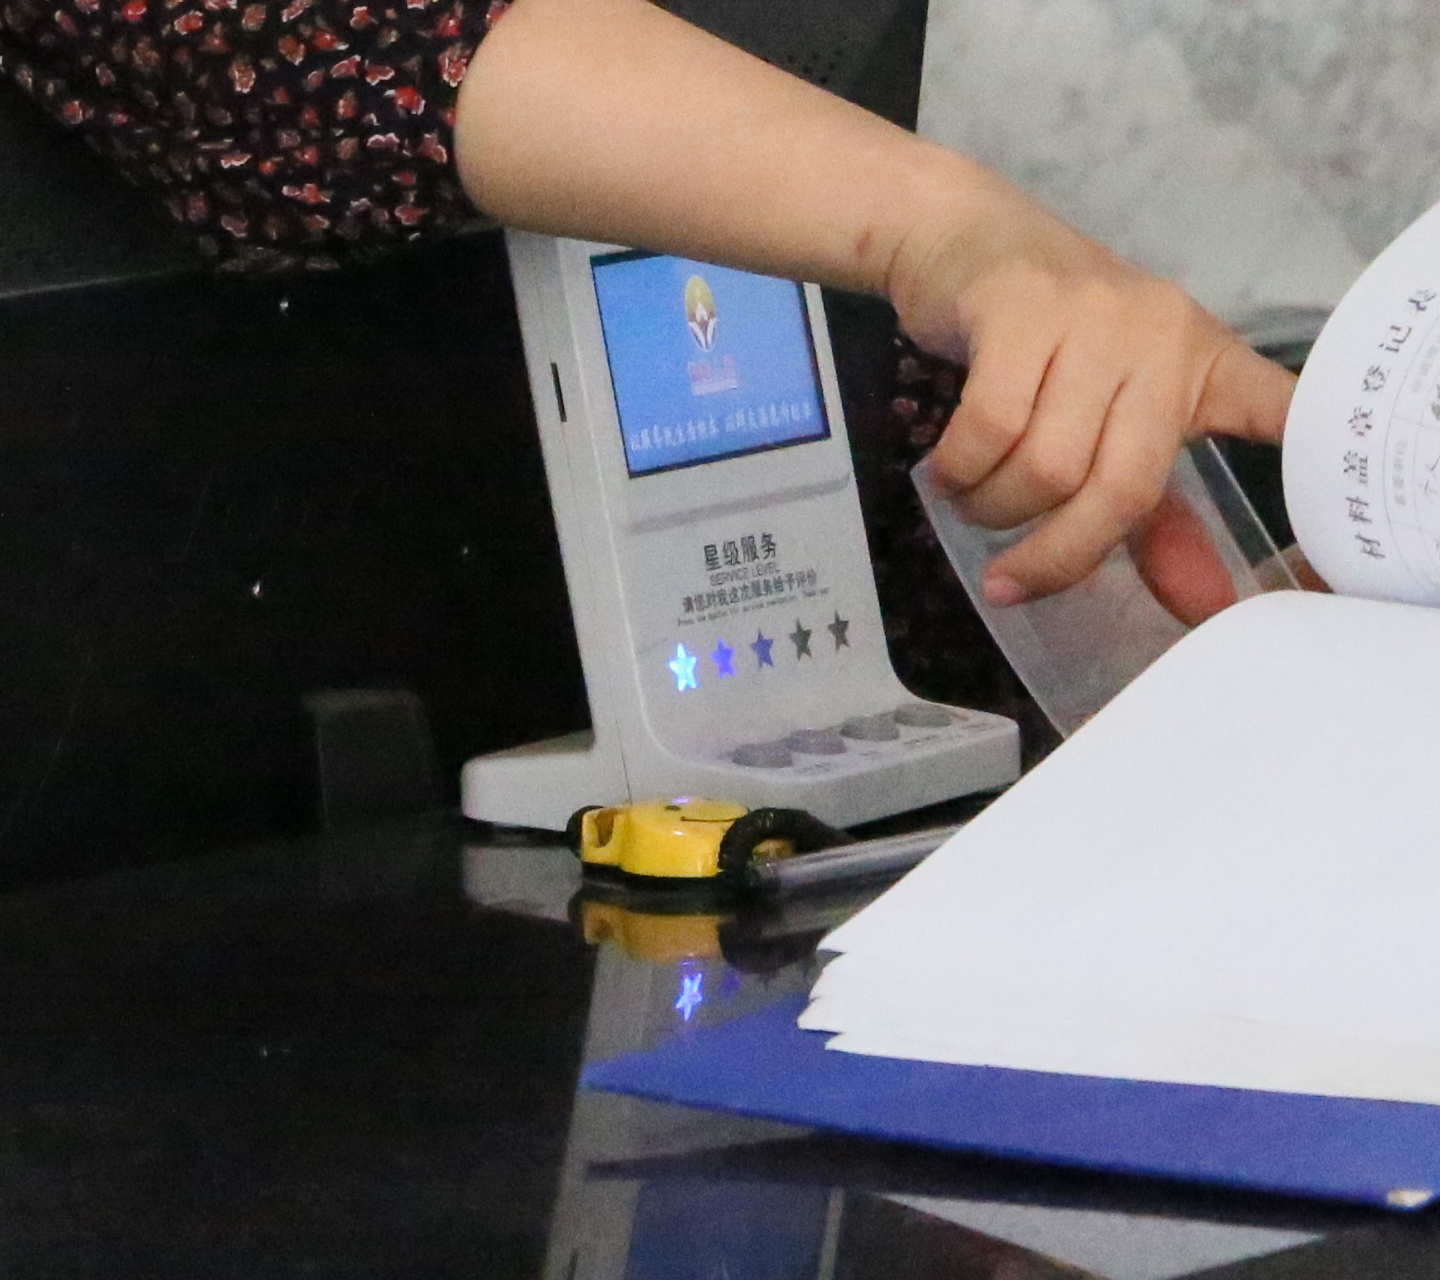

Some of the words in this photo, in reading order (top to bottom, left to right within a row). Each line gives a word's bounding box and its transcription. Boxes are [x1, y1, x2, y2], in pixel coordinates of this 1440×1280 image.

[703, 532, 778, 572] 星级服务
[709, 567, 750, 587] SERVICE
[751, 561, 782, 578] LEVEL
